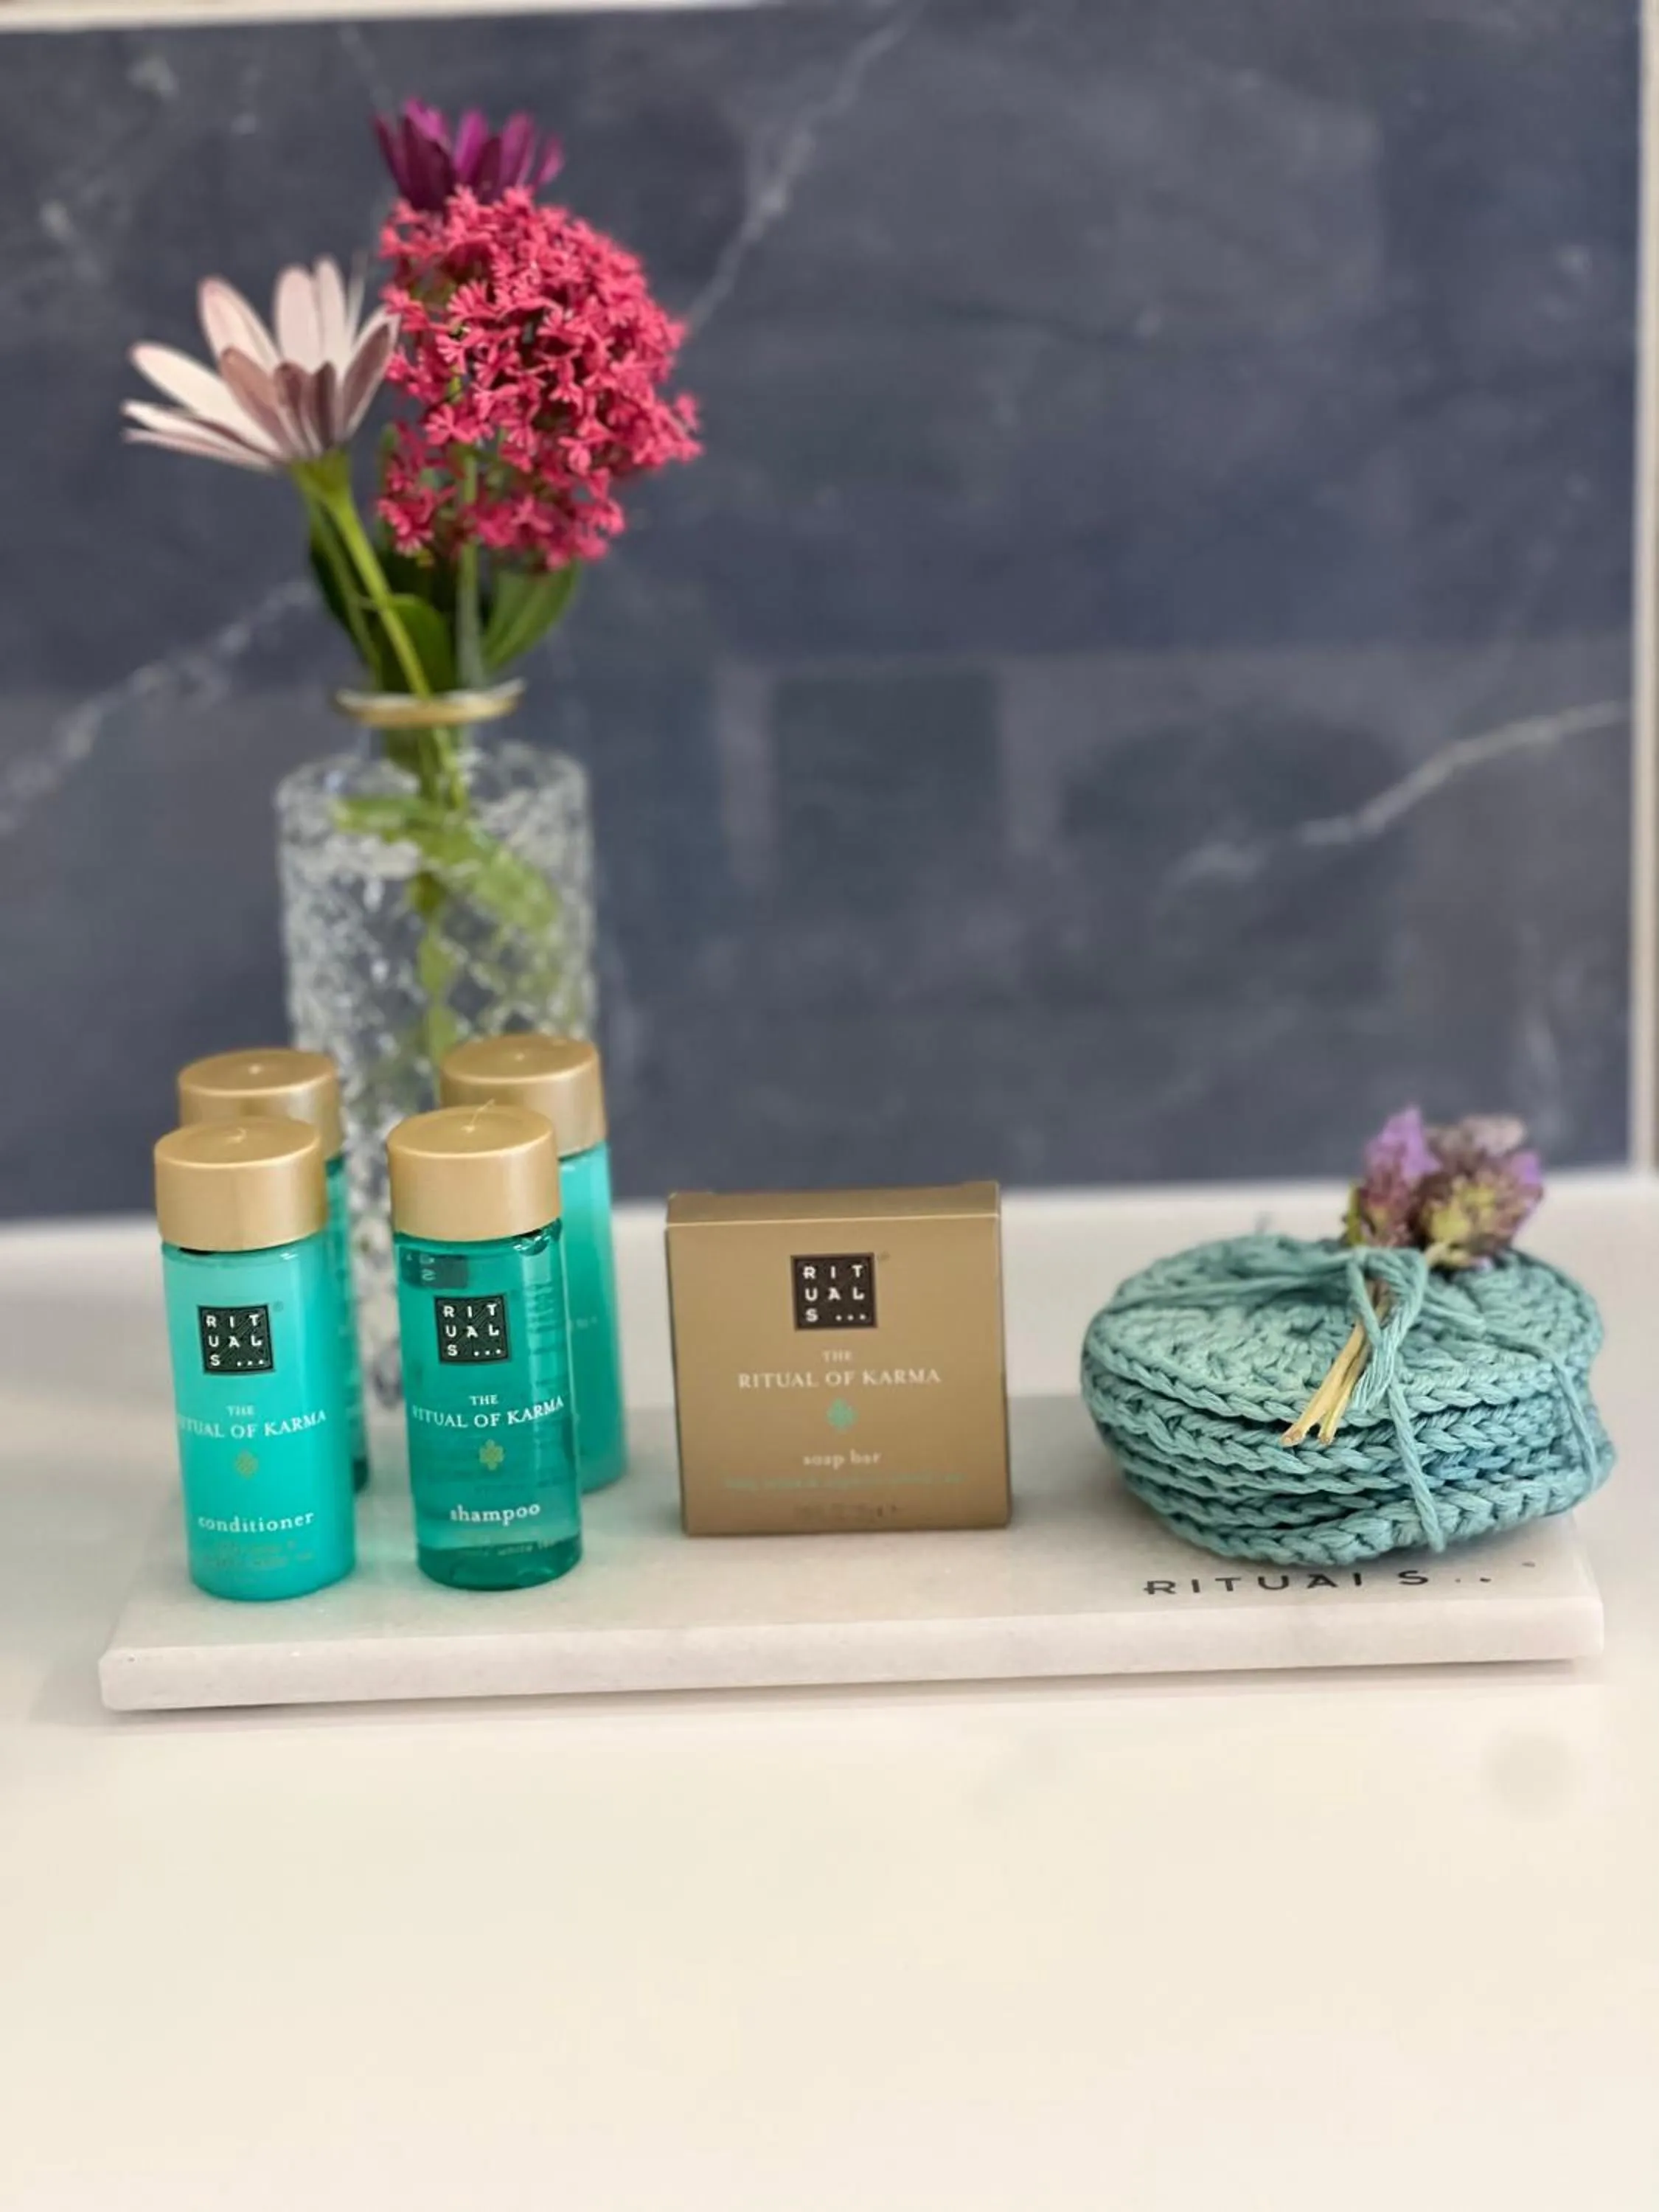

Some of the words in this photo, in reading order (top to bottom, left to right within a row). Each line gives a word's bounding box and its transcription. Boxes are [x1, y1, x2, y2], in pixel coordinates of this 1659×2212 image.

[822, 1350, 853, 1363] THE
[738, 1371, 818, 1389] RITUAL
[825, 1370, 855, 1387] OF
[863, 1368, 942, 1386] KARMA
[226, 1405, 255, 1416] THE
[469, 1394, 498, 1406] THE
[474, 1412, 501, 1428] OF
[507, 1395, 564, 1425] KARMA
[230, 1423, 257, 1439] OF
[264, 1409, 327, 1437] KARMA
[803, 1454, 845, 1470] soap
[849, 1448, 882, 1464] bar
[198, 1512, 314, 1533] conditioner
[451, 1503, 541, 1527] shampoo
